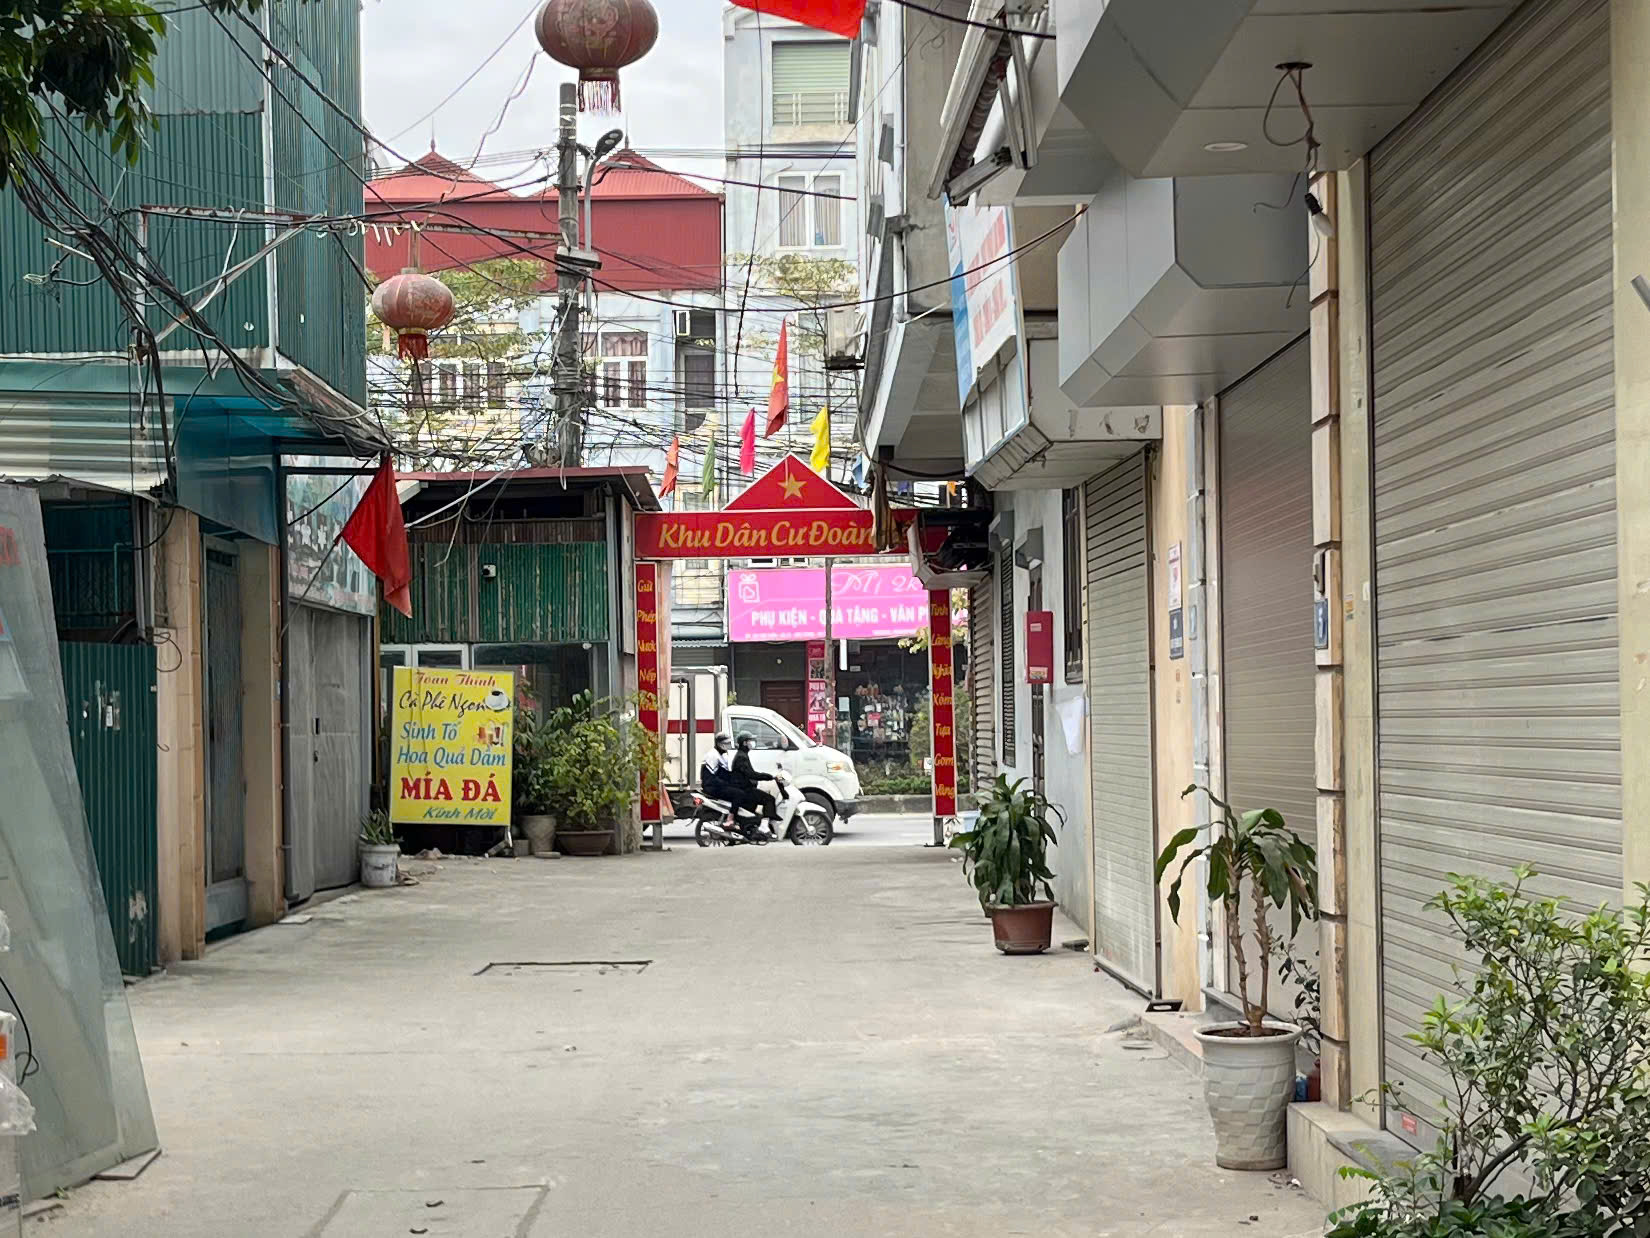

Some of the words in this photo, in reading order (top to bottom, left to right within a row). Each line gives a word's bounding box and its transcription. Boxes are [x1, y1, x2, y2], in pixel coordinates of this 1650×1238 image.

[658, 523, 710, 548] Khu
[714, 522, 767, 548] Dân
[772, 521, 807, 546] Cư
[808, 520, 873, 546] Đoàn
[751, 611, 776, 629] PHỤ
[778, 607, 808, 628] KIỆN
[846, 605, 879, 627] TẶNG
[889, 604, 915, 623] VĂN
[421, 690, 447, 711] Phê
[449, 693, 488, 718] Ngon
[400, 721, 436, 740] Sinh
[441, 720, 462, 741] Tố
[397, 745, 428, 764] Hoa
[461, 773, 502, 802] ĐÁ
